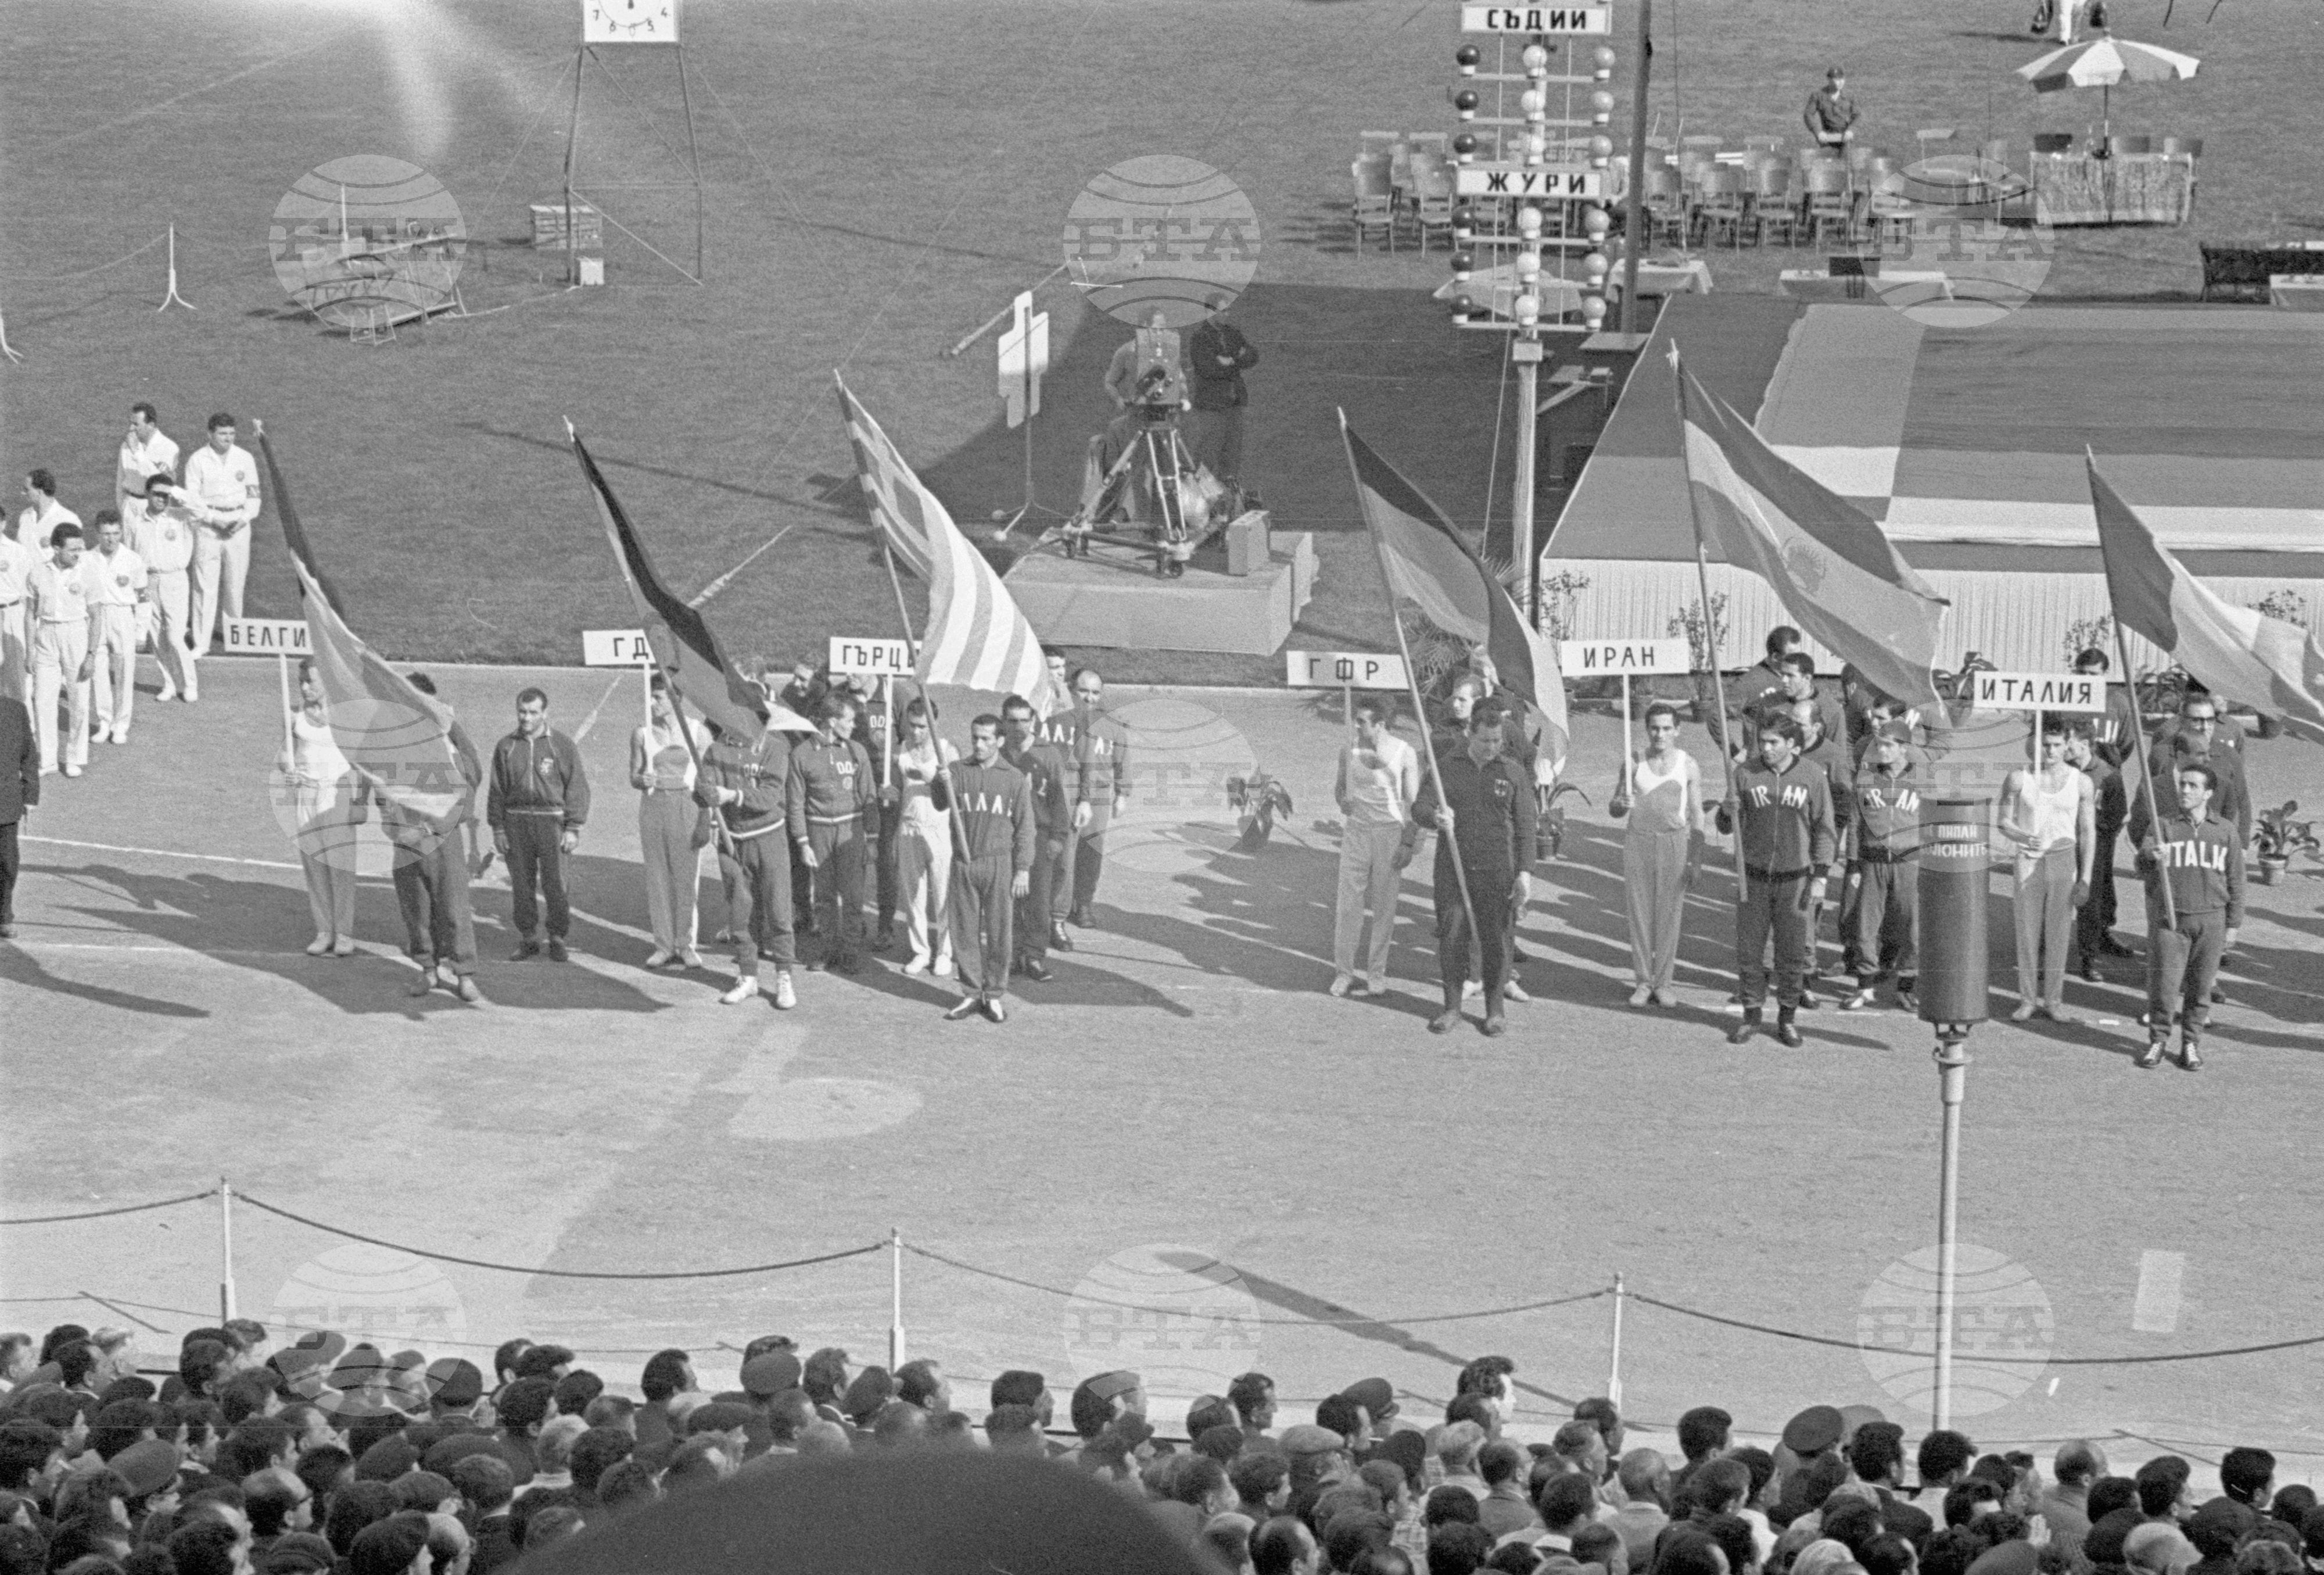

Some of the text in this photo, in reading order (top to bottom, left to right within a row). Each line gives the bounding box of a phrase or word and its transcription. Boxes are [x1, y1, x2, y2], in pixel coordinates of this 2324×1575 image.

[593, 9, 600, 22] 7
[1487, 9, 1587, 30] СЪДИИ
[609, 20, 616, 33] 6
[1487, 173, 1586, 194] ЖУРИ
[1583, 646, 1655, 668] ИРАН
[1309, 657, 1379, 682] ГФР
[1982, 678, 2092, 704] ИТАЛИЯ
